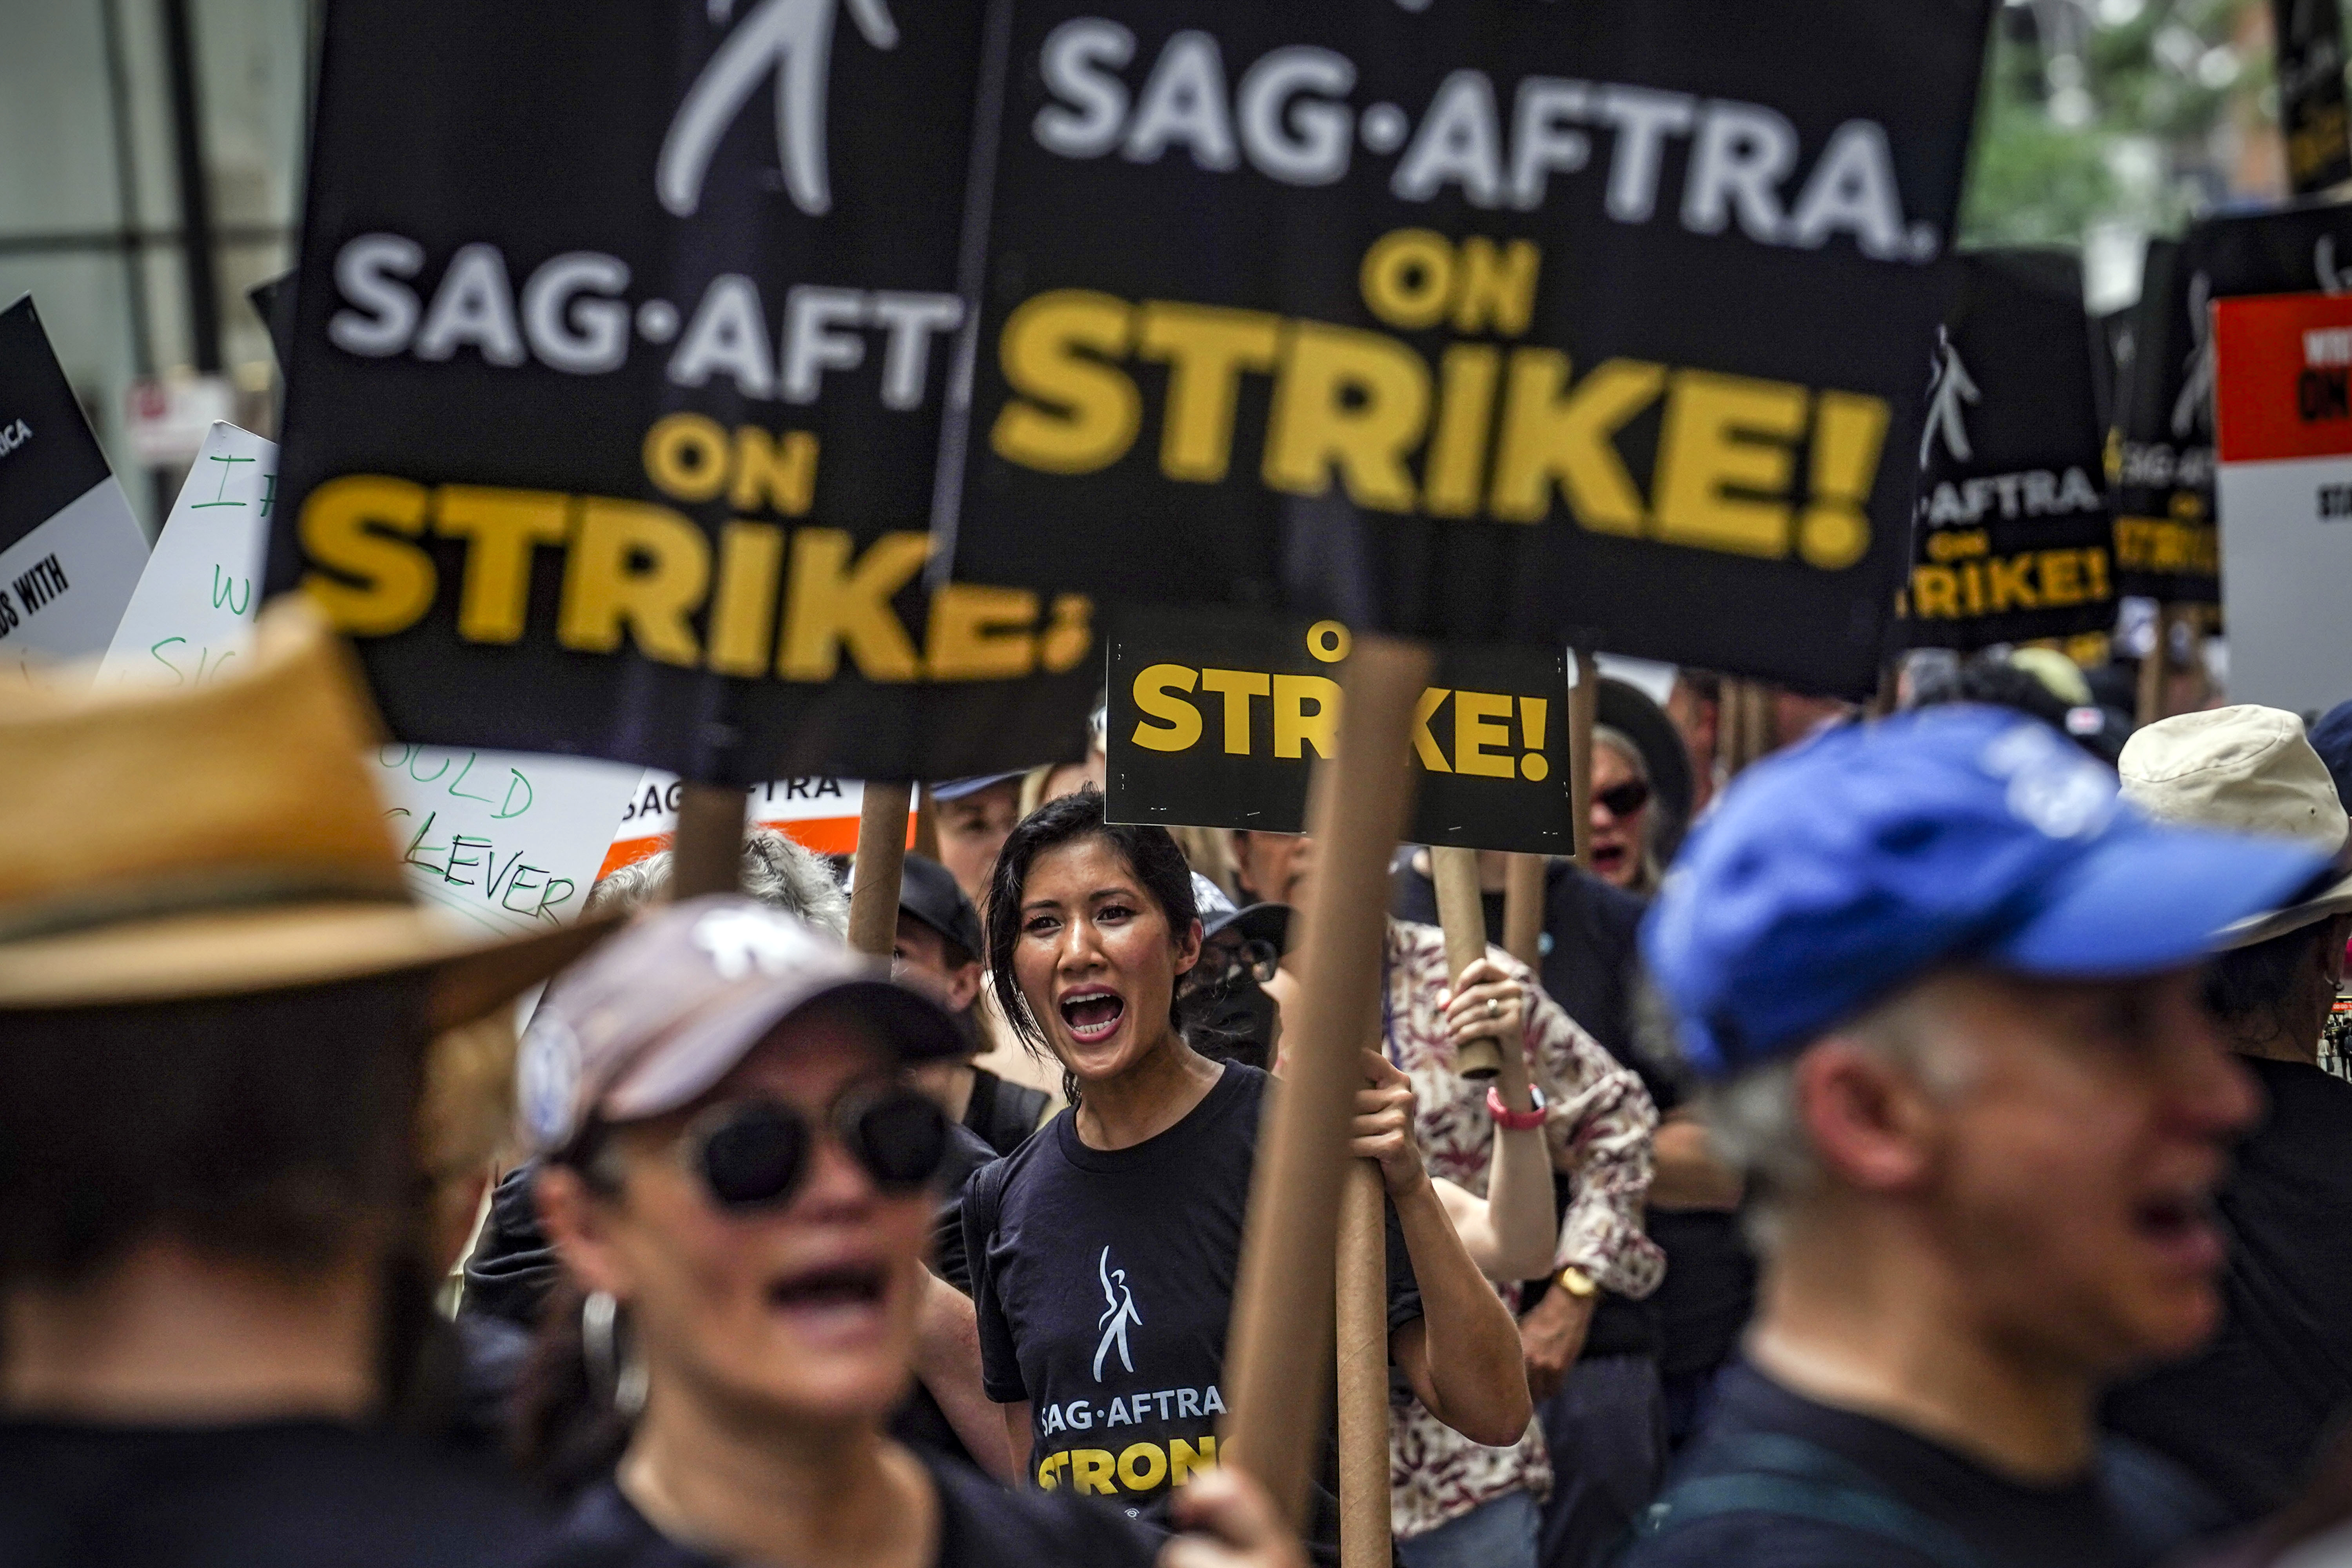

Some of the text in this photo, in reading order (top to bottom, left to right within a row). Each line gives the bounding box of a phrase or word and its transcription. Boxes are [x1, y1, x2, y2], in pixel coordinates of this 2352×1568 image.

[328, 231, 964, 410] SAG·AFT
[1358, 227, 1542, 337] ON
[642, 412, 820, 516] ON
[989, 287, 1892, 570] STRIKE!
[12, 552, 69, 615] WITH
[1894, 547, 2111, 619] RIKE!
[1131, 664, 1548, 781] STRKE!
[379, 743, 532, 818] OULD
[1038, 1436, 1239, 1495] STRON
